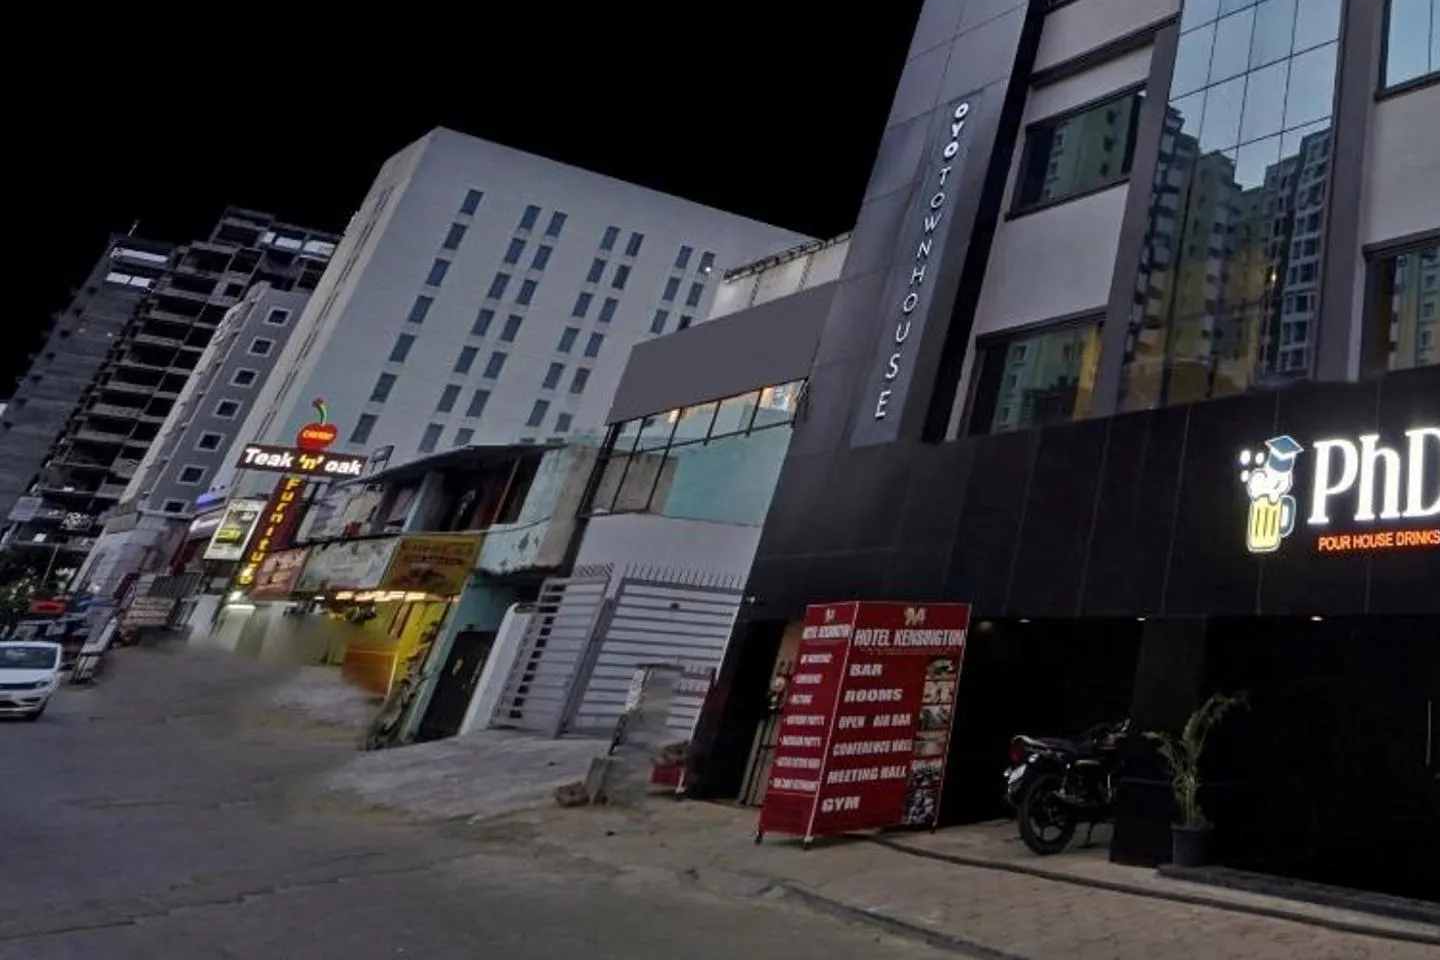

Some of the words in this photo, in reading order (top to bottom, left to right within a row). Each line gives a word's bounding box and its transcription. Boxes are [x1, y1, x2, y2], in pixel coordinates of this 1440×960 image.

[943, 103, 969, 159] OYO
[874, 166, 951, 419] TOWNHOUSE
[244, 448, 294, 468] Teak
[324, 460, 362, 475] oak
[239, 477, 301, 585] Furniture
[1318, 535, 1351, 551] POUR
[1353, 532, 1394, 548] HOUSE
[1395, 529, 1440, 546] DRINKS
[854, 628, 890, 646] HOTEL
[893, 628, 966, 646] KENSINGTON
[849, 663, 883, 677] BAR
[844, 688, 903, 703] ROOMS
[838, 715, 866, 729] OPEN
[827, 767, 878, 784] MEETING
[880, 765, 907, 779] HALL
[821, 795, 861, 813] GYM
